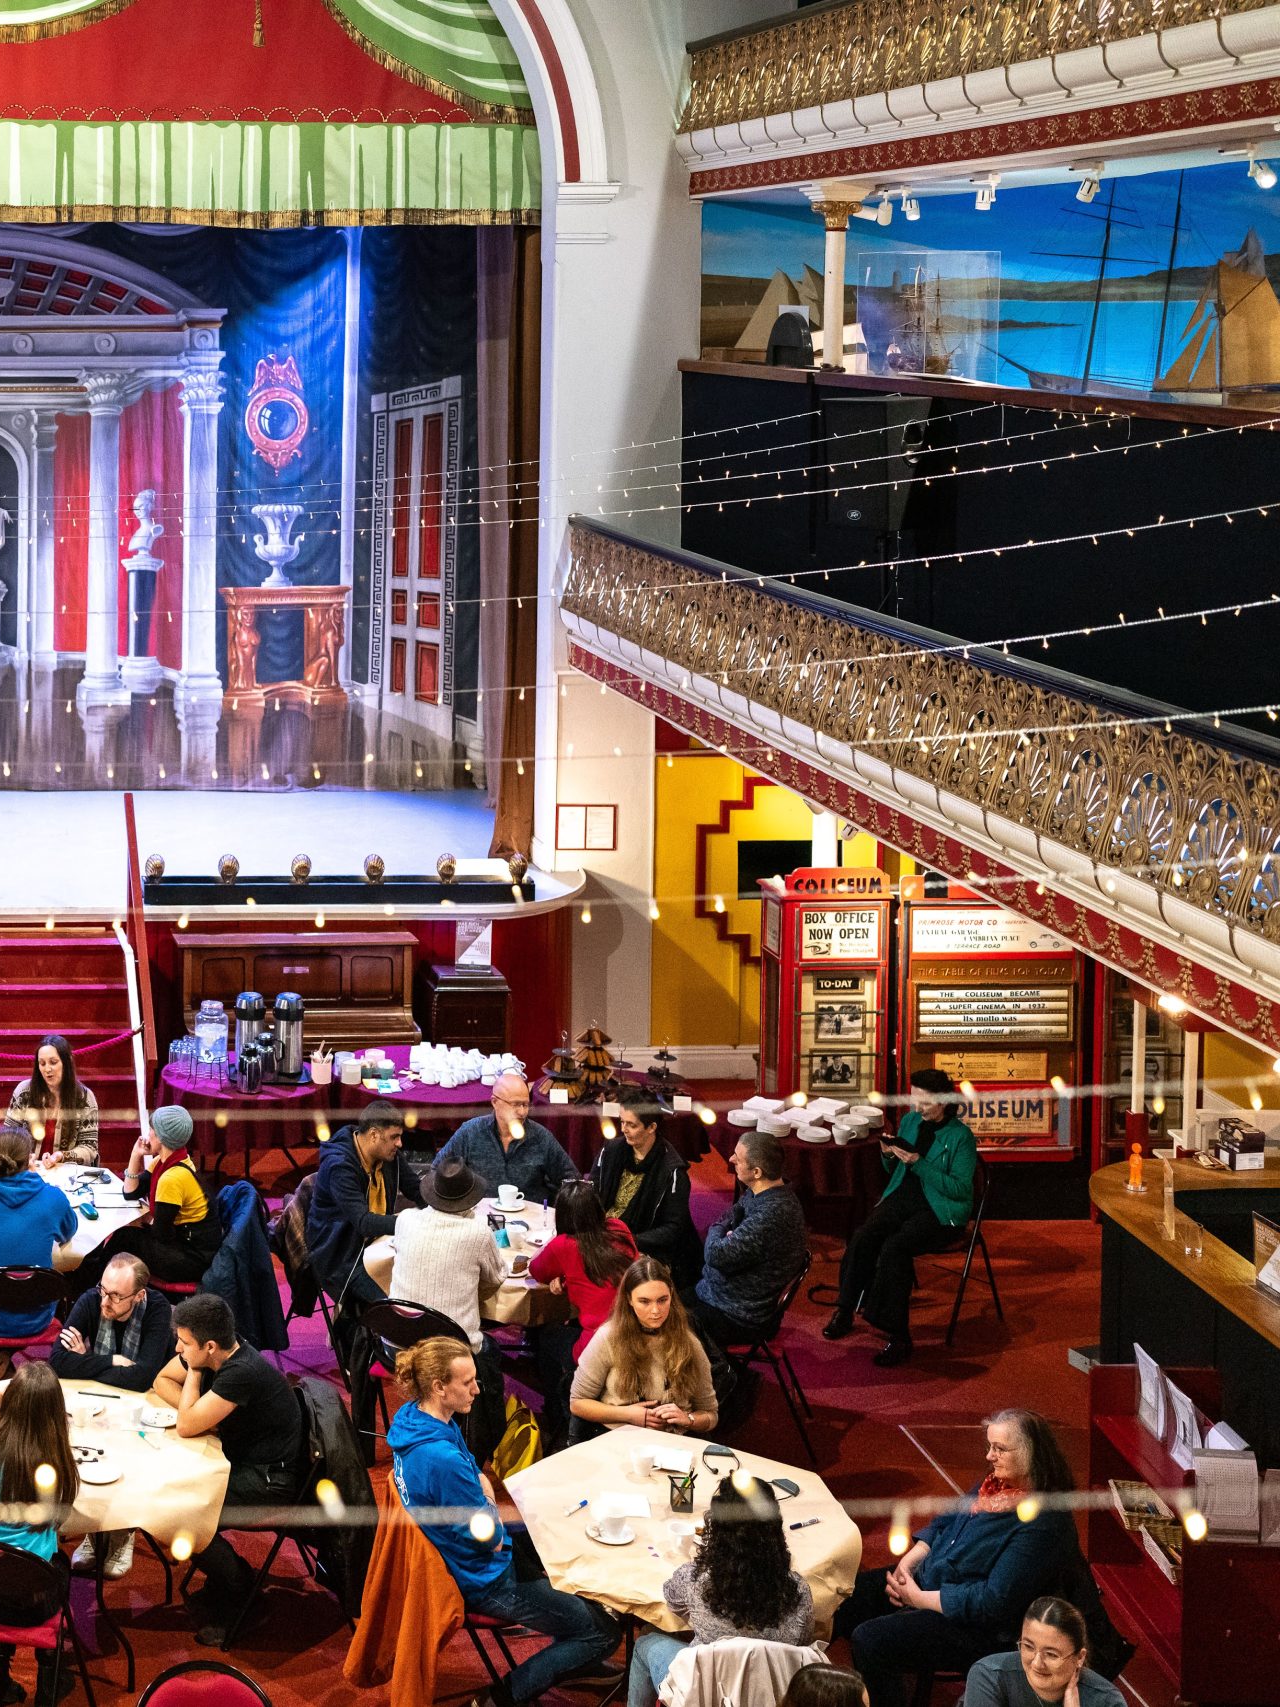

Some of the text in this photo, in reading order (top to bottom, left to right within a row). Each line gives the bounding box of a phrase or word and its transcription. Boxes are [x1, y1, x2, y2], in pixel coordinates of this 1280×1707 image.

[794, 877, 882, 894] COLISEUM
[804, 912, 875, 924] BOX OFFICE
[808, 927, 869, 941] NOW OPEN
[917, 967, 937, 976] TIME
[940, 967, 966, 976] TABLE
[969, 967, 982, 976] OF
[985, 967, 1009, 976] FILMS
[819, 980, 853, 988] TO-DAY
[957, 1100, 1044, 1119] OLISEUM
